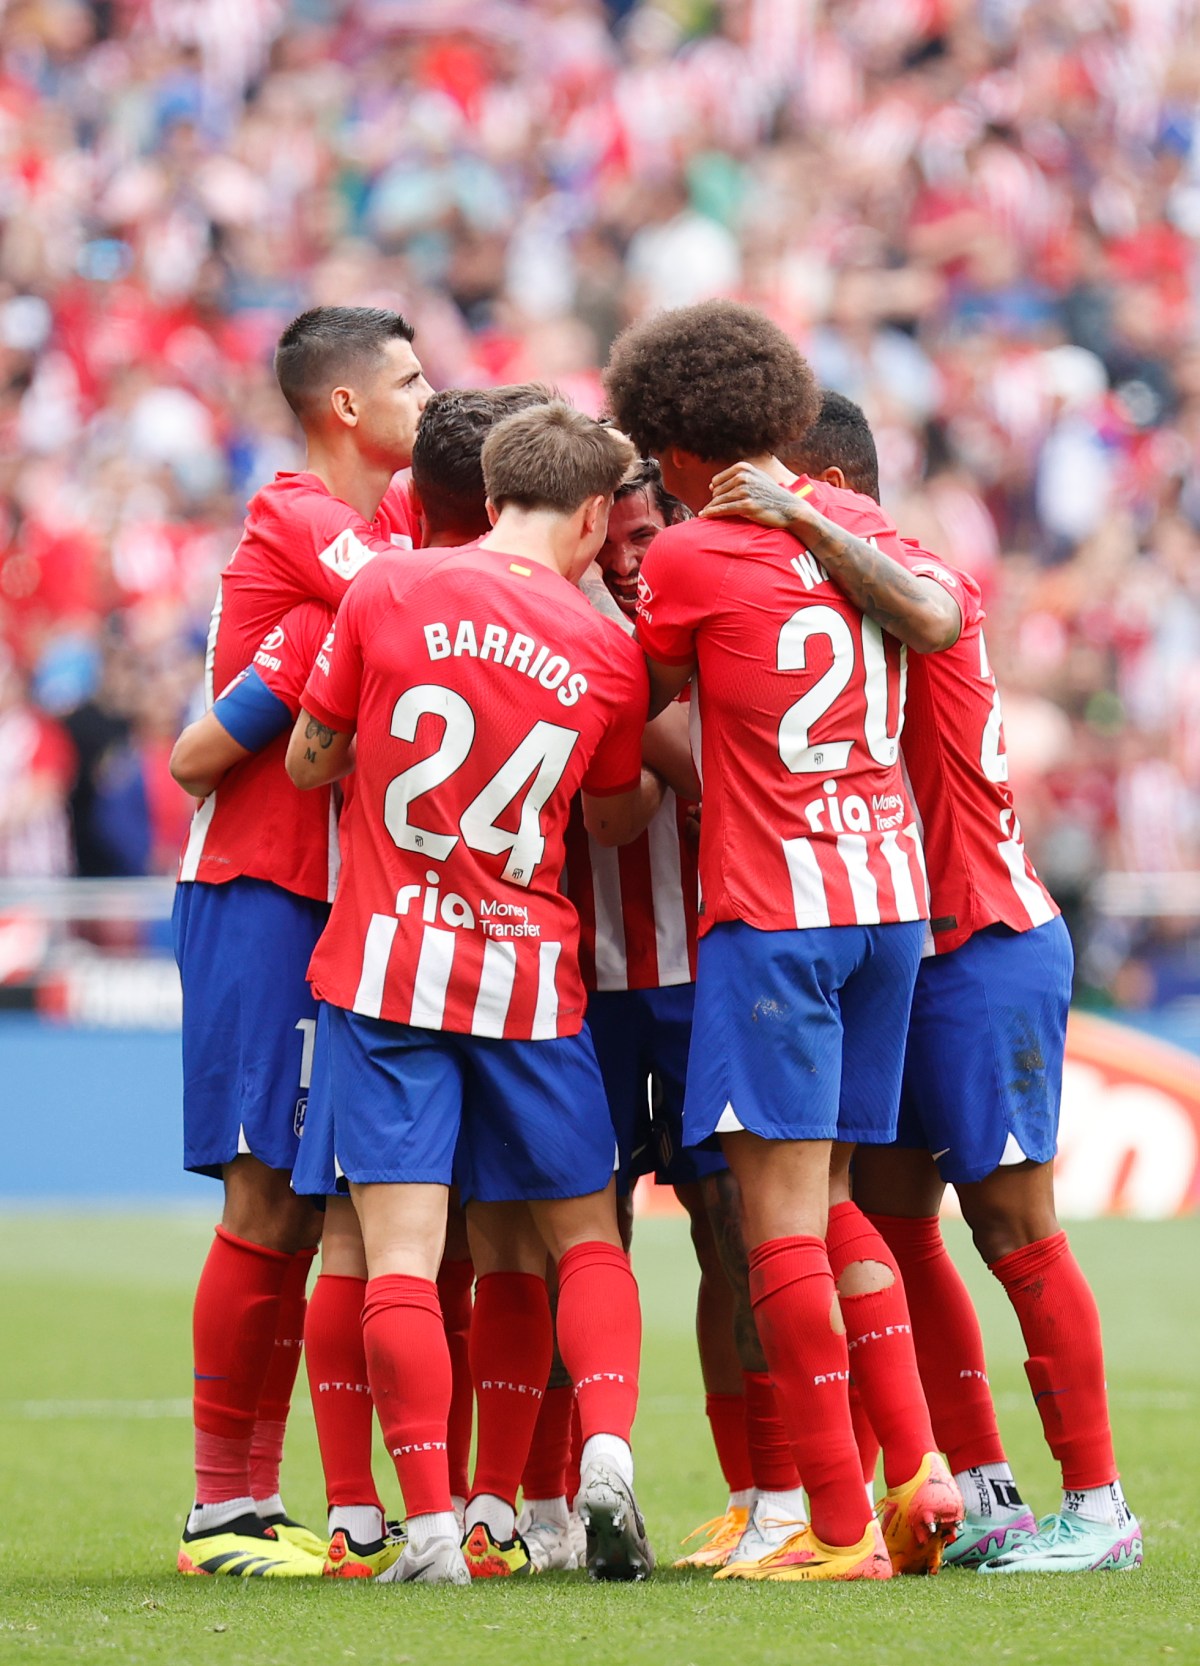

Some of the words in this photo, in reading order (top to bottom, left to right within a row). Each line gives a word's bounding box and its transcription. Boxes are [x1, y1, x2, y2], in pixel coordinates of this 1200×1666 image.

[423, 620, 589, 706] BARRIOS
[383, 683, 581, 888] 24
[804, 778, 872, 833] ria
[395, 869, 476, 930] ria
[480, 899, 529, 920] Money
[479, 920, 541, 937] Transfer
[482, 1380, 543, 1399] ATLETI
[393, 1441, 447, 1457] ATLETI
